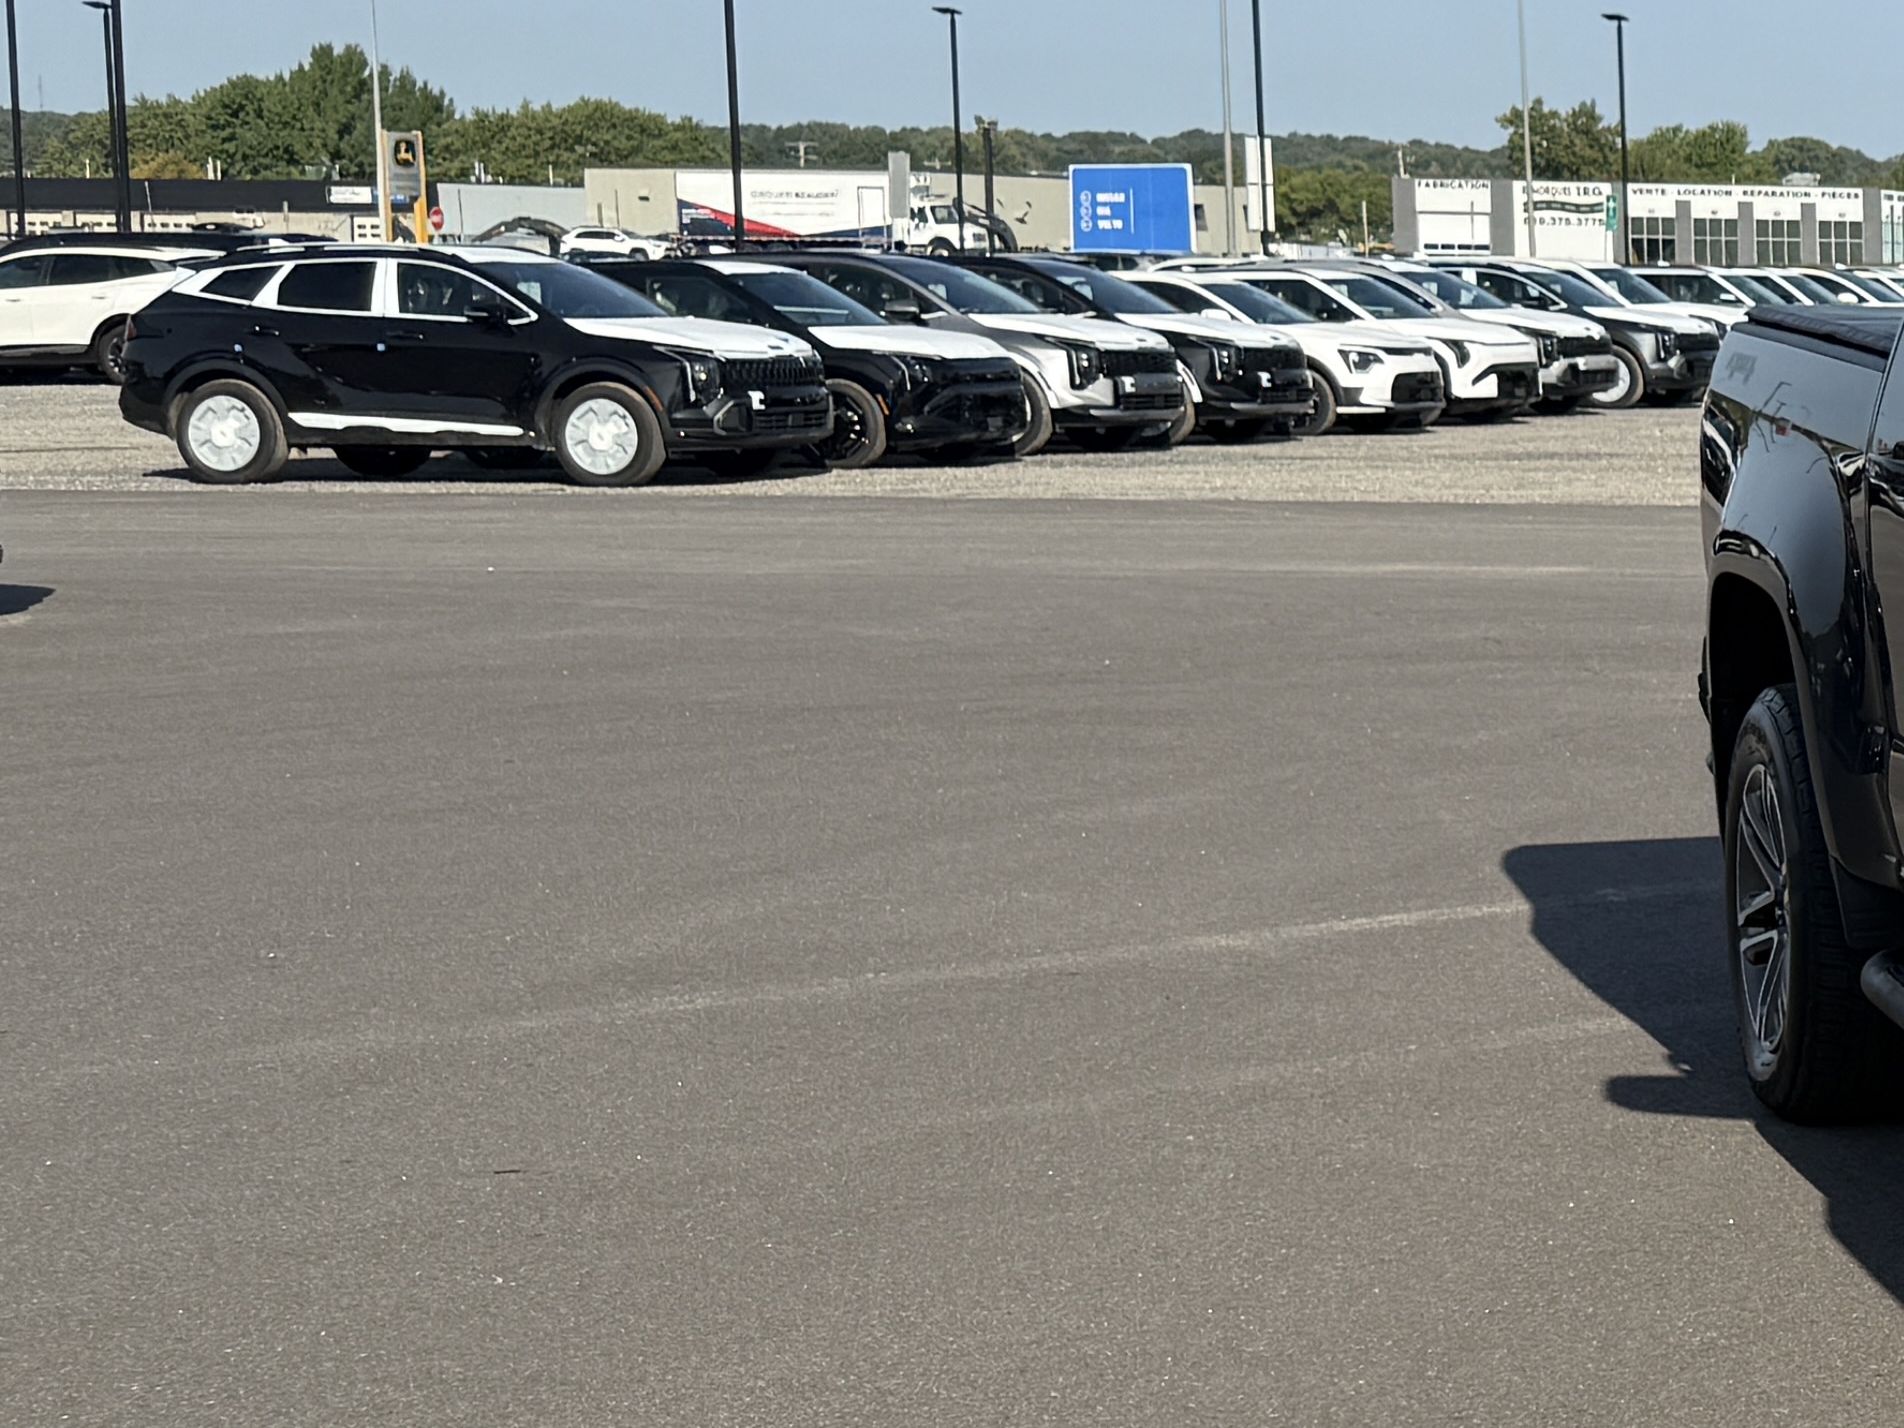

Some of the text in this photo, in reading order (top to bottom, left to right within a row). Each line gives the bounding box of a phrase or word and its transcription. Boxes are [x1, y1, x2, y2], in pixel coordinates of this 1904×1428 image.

[1417, 180, 1490, 190] FABRICATION
[1632, 188, 1667, 196] VENTE
[1677, 188, 1733, 197] LOCATION
